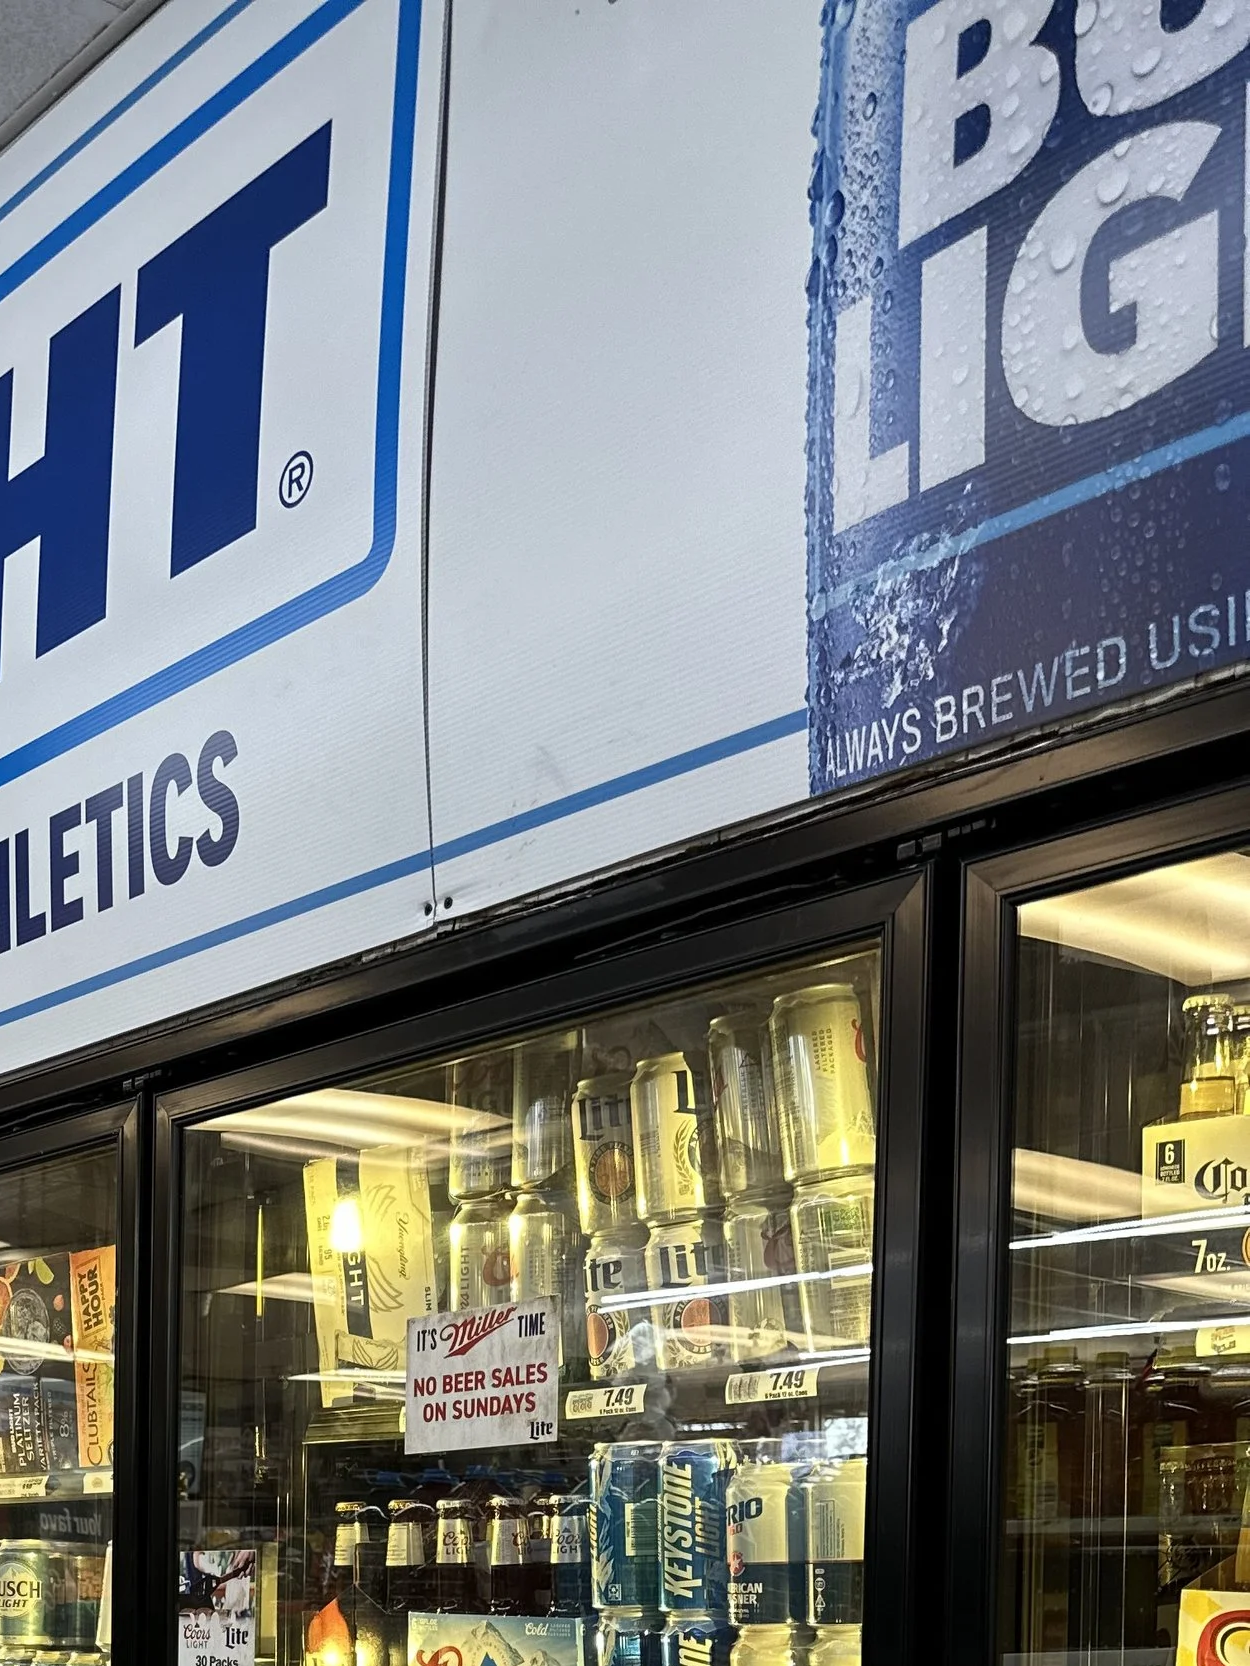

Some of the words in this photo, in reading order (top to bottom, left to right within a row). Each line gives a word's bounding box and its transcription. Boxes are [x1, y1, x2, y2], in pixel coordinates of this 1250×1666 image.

[832, 82, 1250, 540] LIG
[825, 707, 922, 782] ALWAYS
[934, 635, 1127, 744] BREWED
[811, 1030, 822, 1071] LAGERED
[819, 1029, 828, 1072] FILTERED
[826, 1028, 836, 1075] PACKAGED
[1165, 1143, 1175, 1164] 6
[397, 1211, 412, 1280] Yuengling
[76, 1272, 94, 1330] HAPPY
[89, 1264, 106, 1328] HOUR
[425, 1286, 433, 1311] SLIM
[417, 1328, 437, 1352] IT'S
[440, 1306, 518, 1358] Miller
[518, 1312, 546, 1338] TIME
[413, 1376, 437, 1397] NO
[442, 1370, 486, 1395] BEER
[491, 1362, 548, 1389] SALES
[13, 1393, 27, 1467] PLATINUM
[22, 1397, 35, 1461] SELTZER
[423, 1401, 447, 1423] ON
[452, 1392, 536, 1420] SUNDAYS
[529, 1421, 553, 1440] Lite
[663, 1460, 693, 1599] KEYSTONE
[183, 1624, 210, 1640] Coors
[225, 1627, 248, 1649] Lite
[186, 1640, 208, 1649] LIGHT
[524, 1622, 549, 1636] Cold
